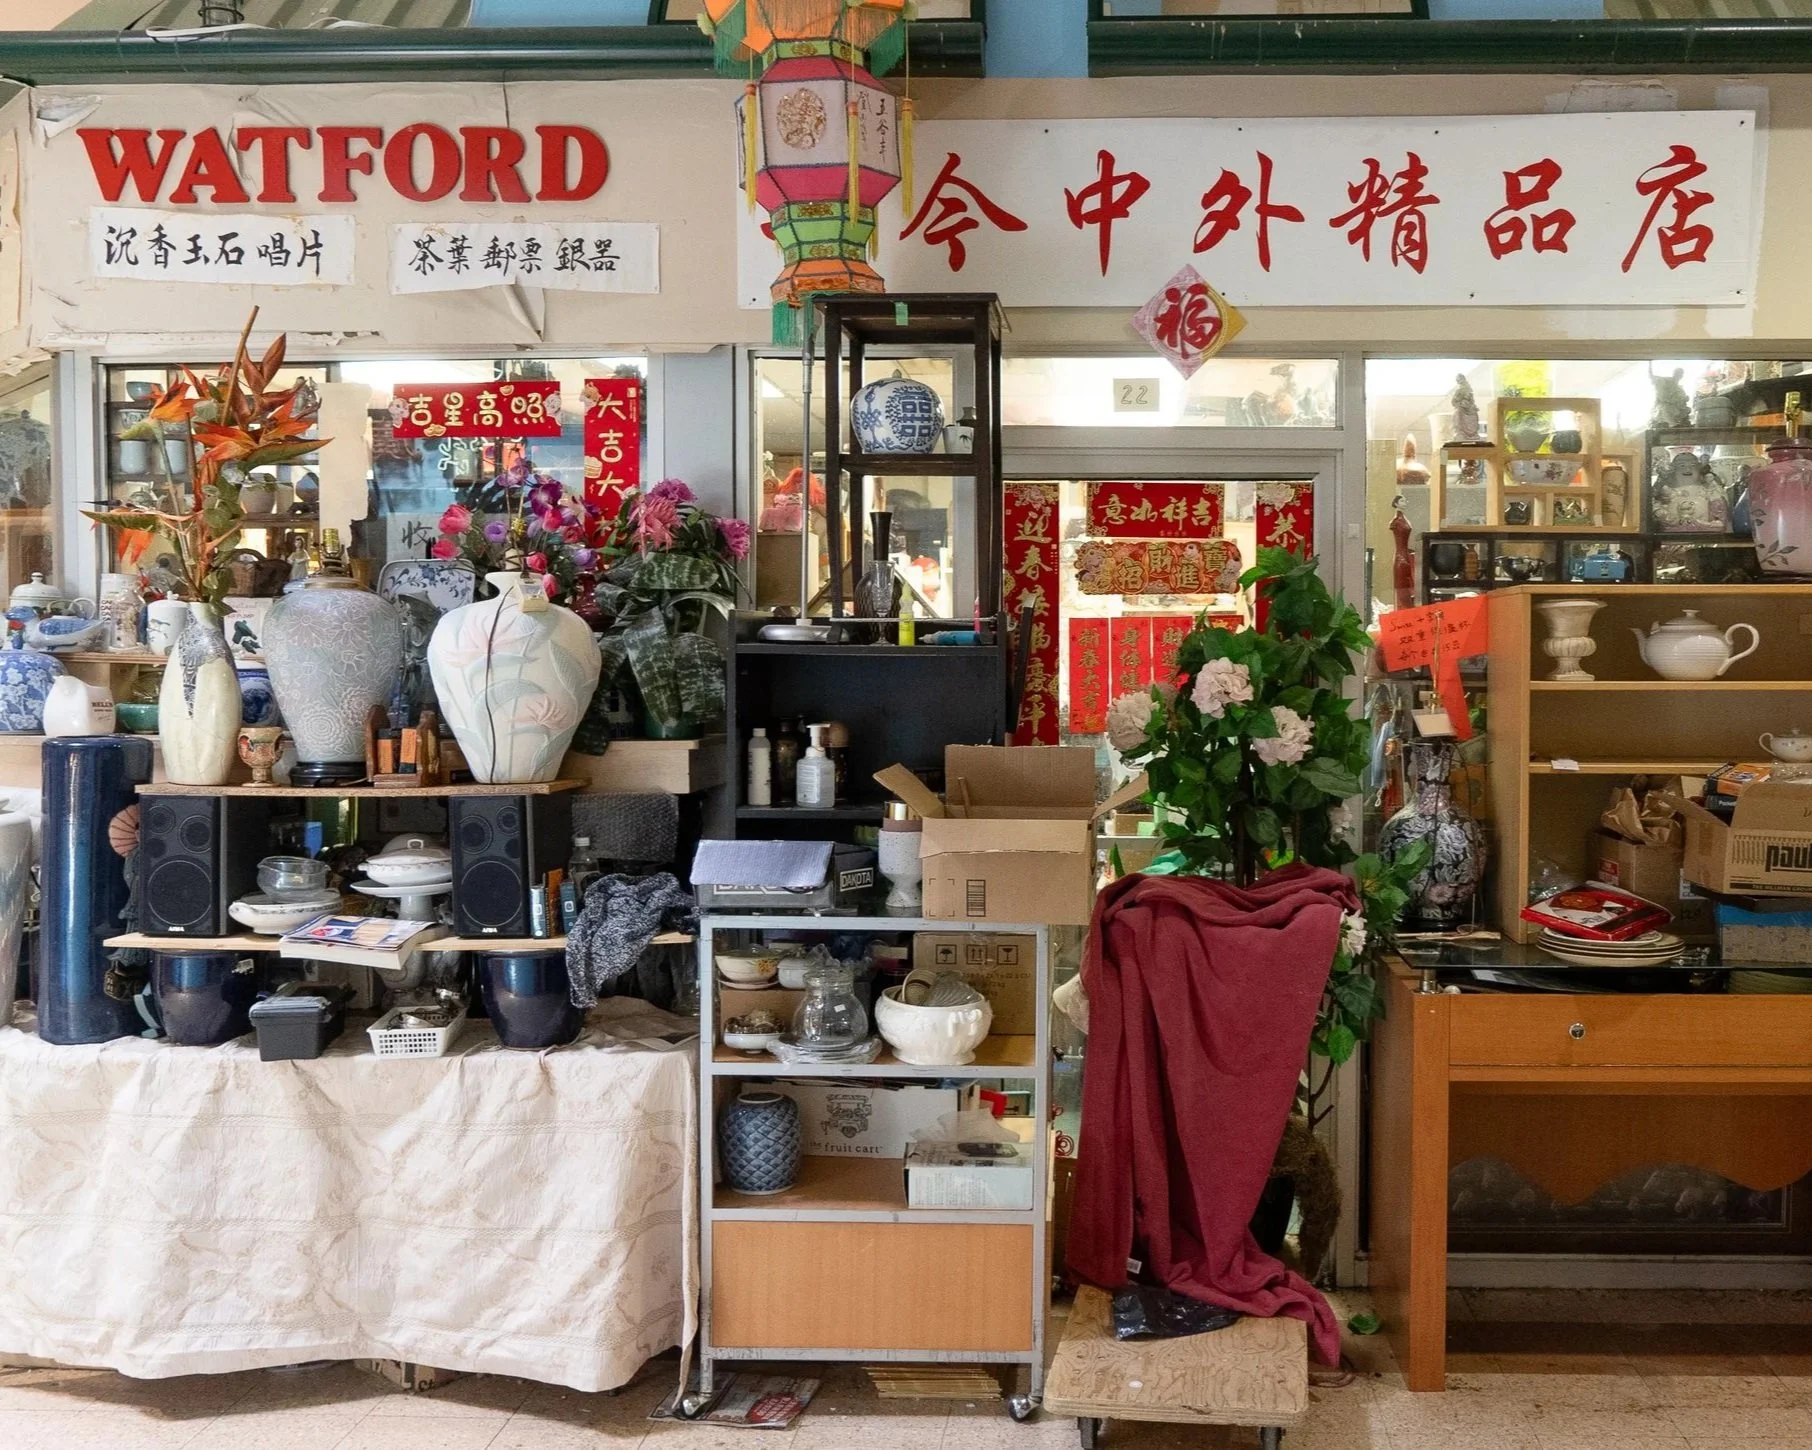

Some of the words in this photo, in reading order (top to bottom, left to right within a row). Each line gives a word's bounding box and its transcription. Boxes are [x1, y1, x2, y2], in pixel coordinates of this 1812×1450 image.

[76, 124, 609, 204] WATFORD
[760, 145, 1716, 275] 今中外精品店
[103, 222, 324, 275] 沉香玉石唱片
[407, 234, 621, 277] 茶葉郵票銀器
[1153, 283, 1223, 360] 福
[409, 390, 545, 428] 吉星高照
[1120, 384, 1149, 405] 22
[402, 520, 433, 549] 收
[1765, 844, 1812, 873] pau
[840, 870, 873, 890] DAKOTA
[824, 1142, 852, 1153] fruit
[855, 1144, 880, 1154] cart
